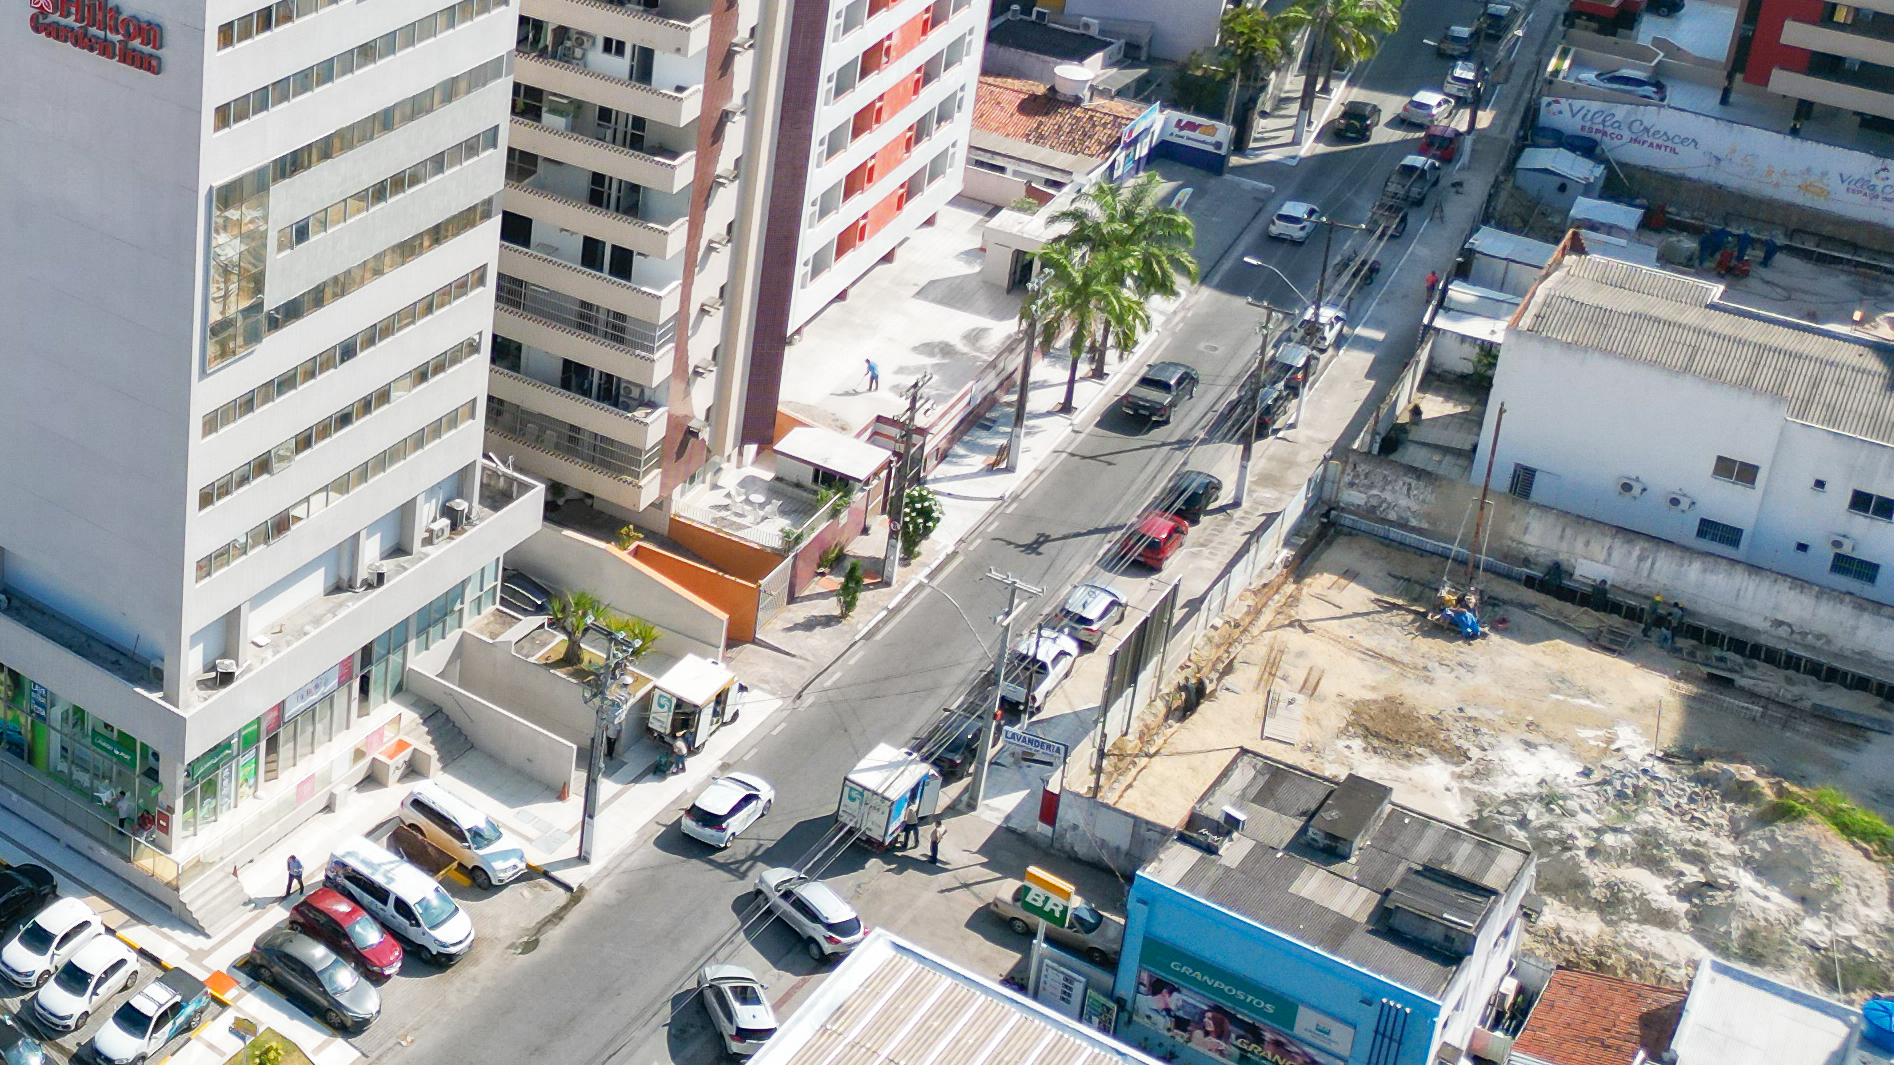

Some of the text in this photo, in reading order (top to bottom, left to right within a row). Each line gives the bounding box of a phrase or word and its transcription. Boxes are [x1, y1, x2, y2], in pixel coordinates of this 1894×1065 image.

[29, 10, 162, 75] Garden Inn
[1568, 102, 1700, 150] Villa Crescer
[1580, 125, 1679, 155] ESPAÇO INFANTIL
[1839, 172, 1879, 191] Villa
[1004, 729, 1062, 755] LAVANDERIA
[1025, 887, 1064, 918] BR
[1169, 961, 1276, 1014] GRANPOSTOS
